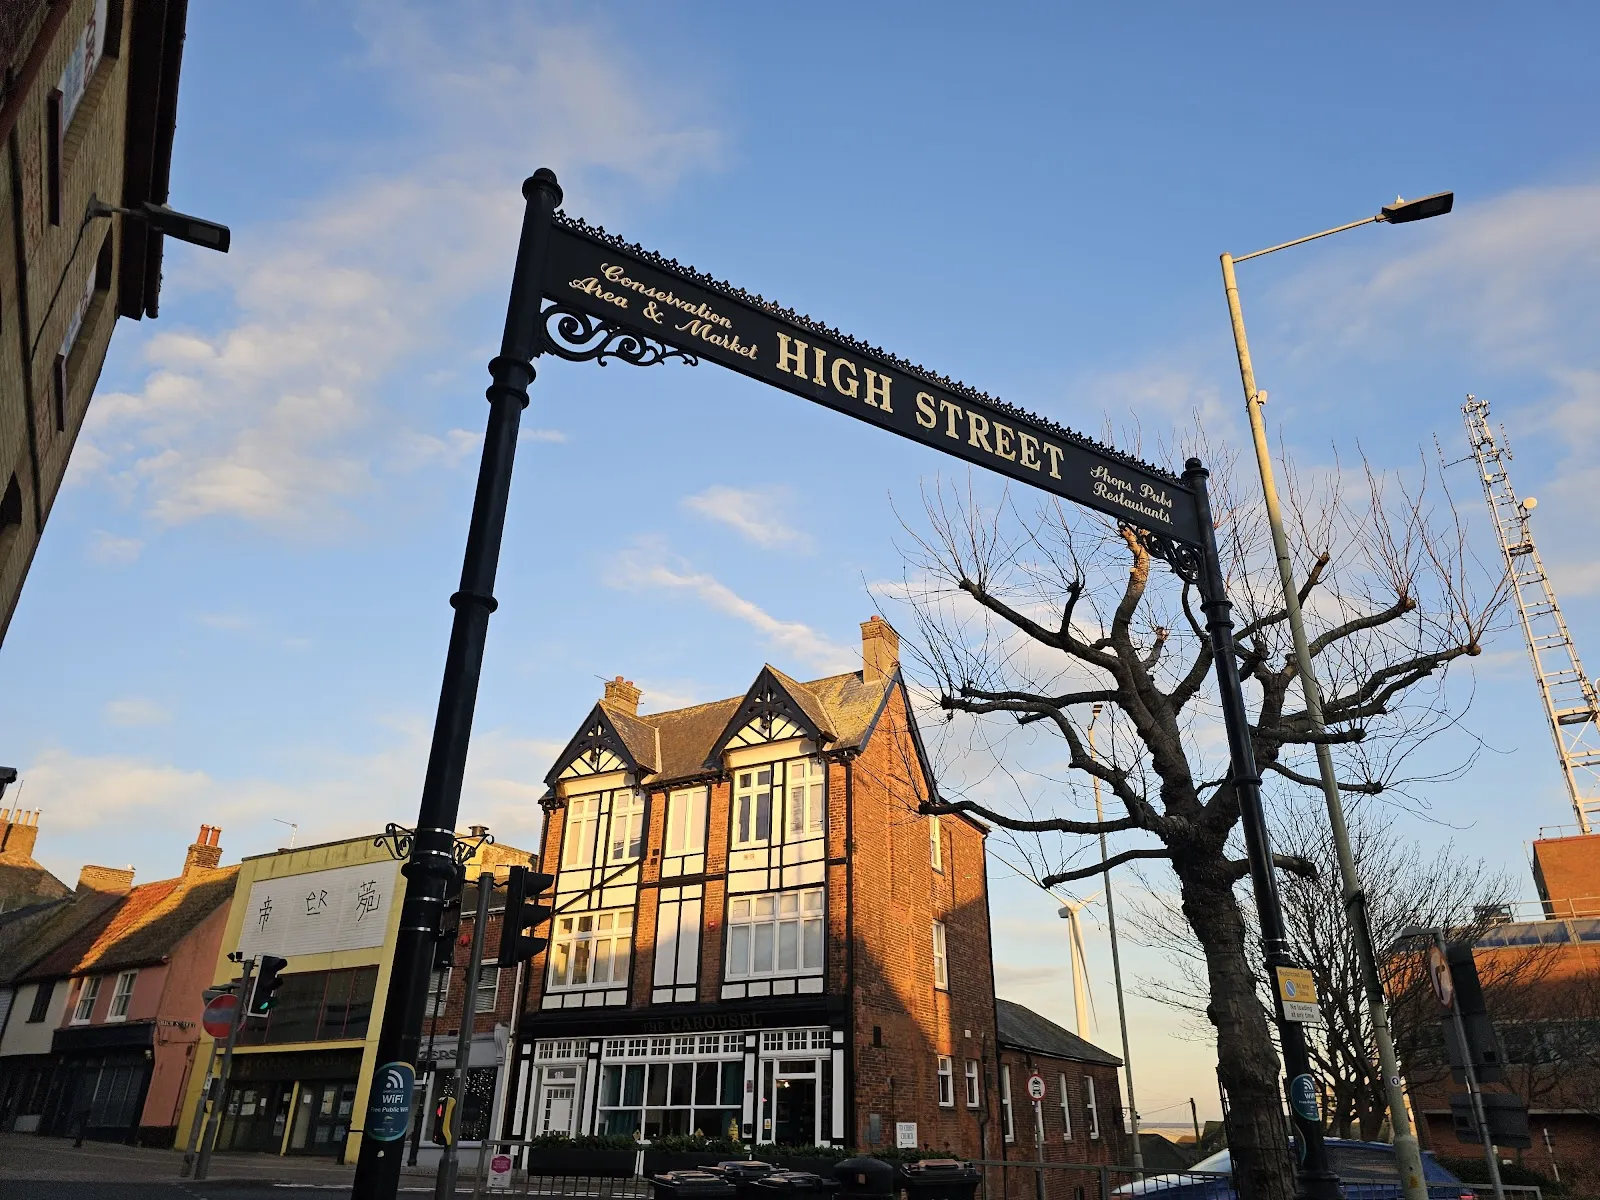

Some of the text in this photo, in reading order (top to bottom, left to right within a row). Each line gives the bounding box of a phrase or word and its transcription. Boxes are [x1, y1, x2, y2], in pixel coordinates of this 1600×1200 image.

[600, 262, 732, 329] Conservation
[568, 277, 759, 361] Area & Market
[775, 331, 1065, 480] HIGH STREET
[1139, 483, 1173, 508] Pubs
[670, 1012, 763, 1031] CAROUSEL
[382, 1094, 404, 1104] WiFi
